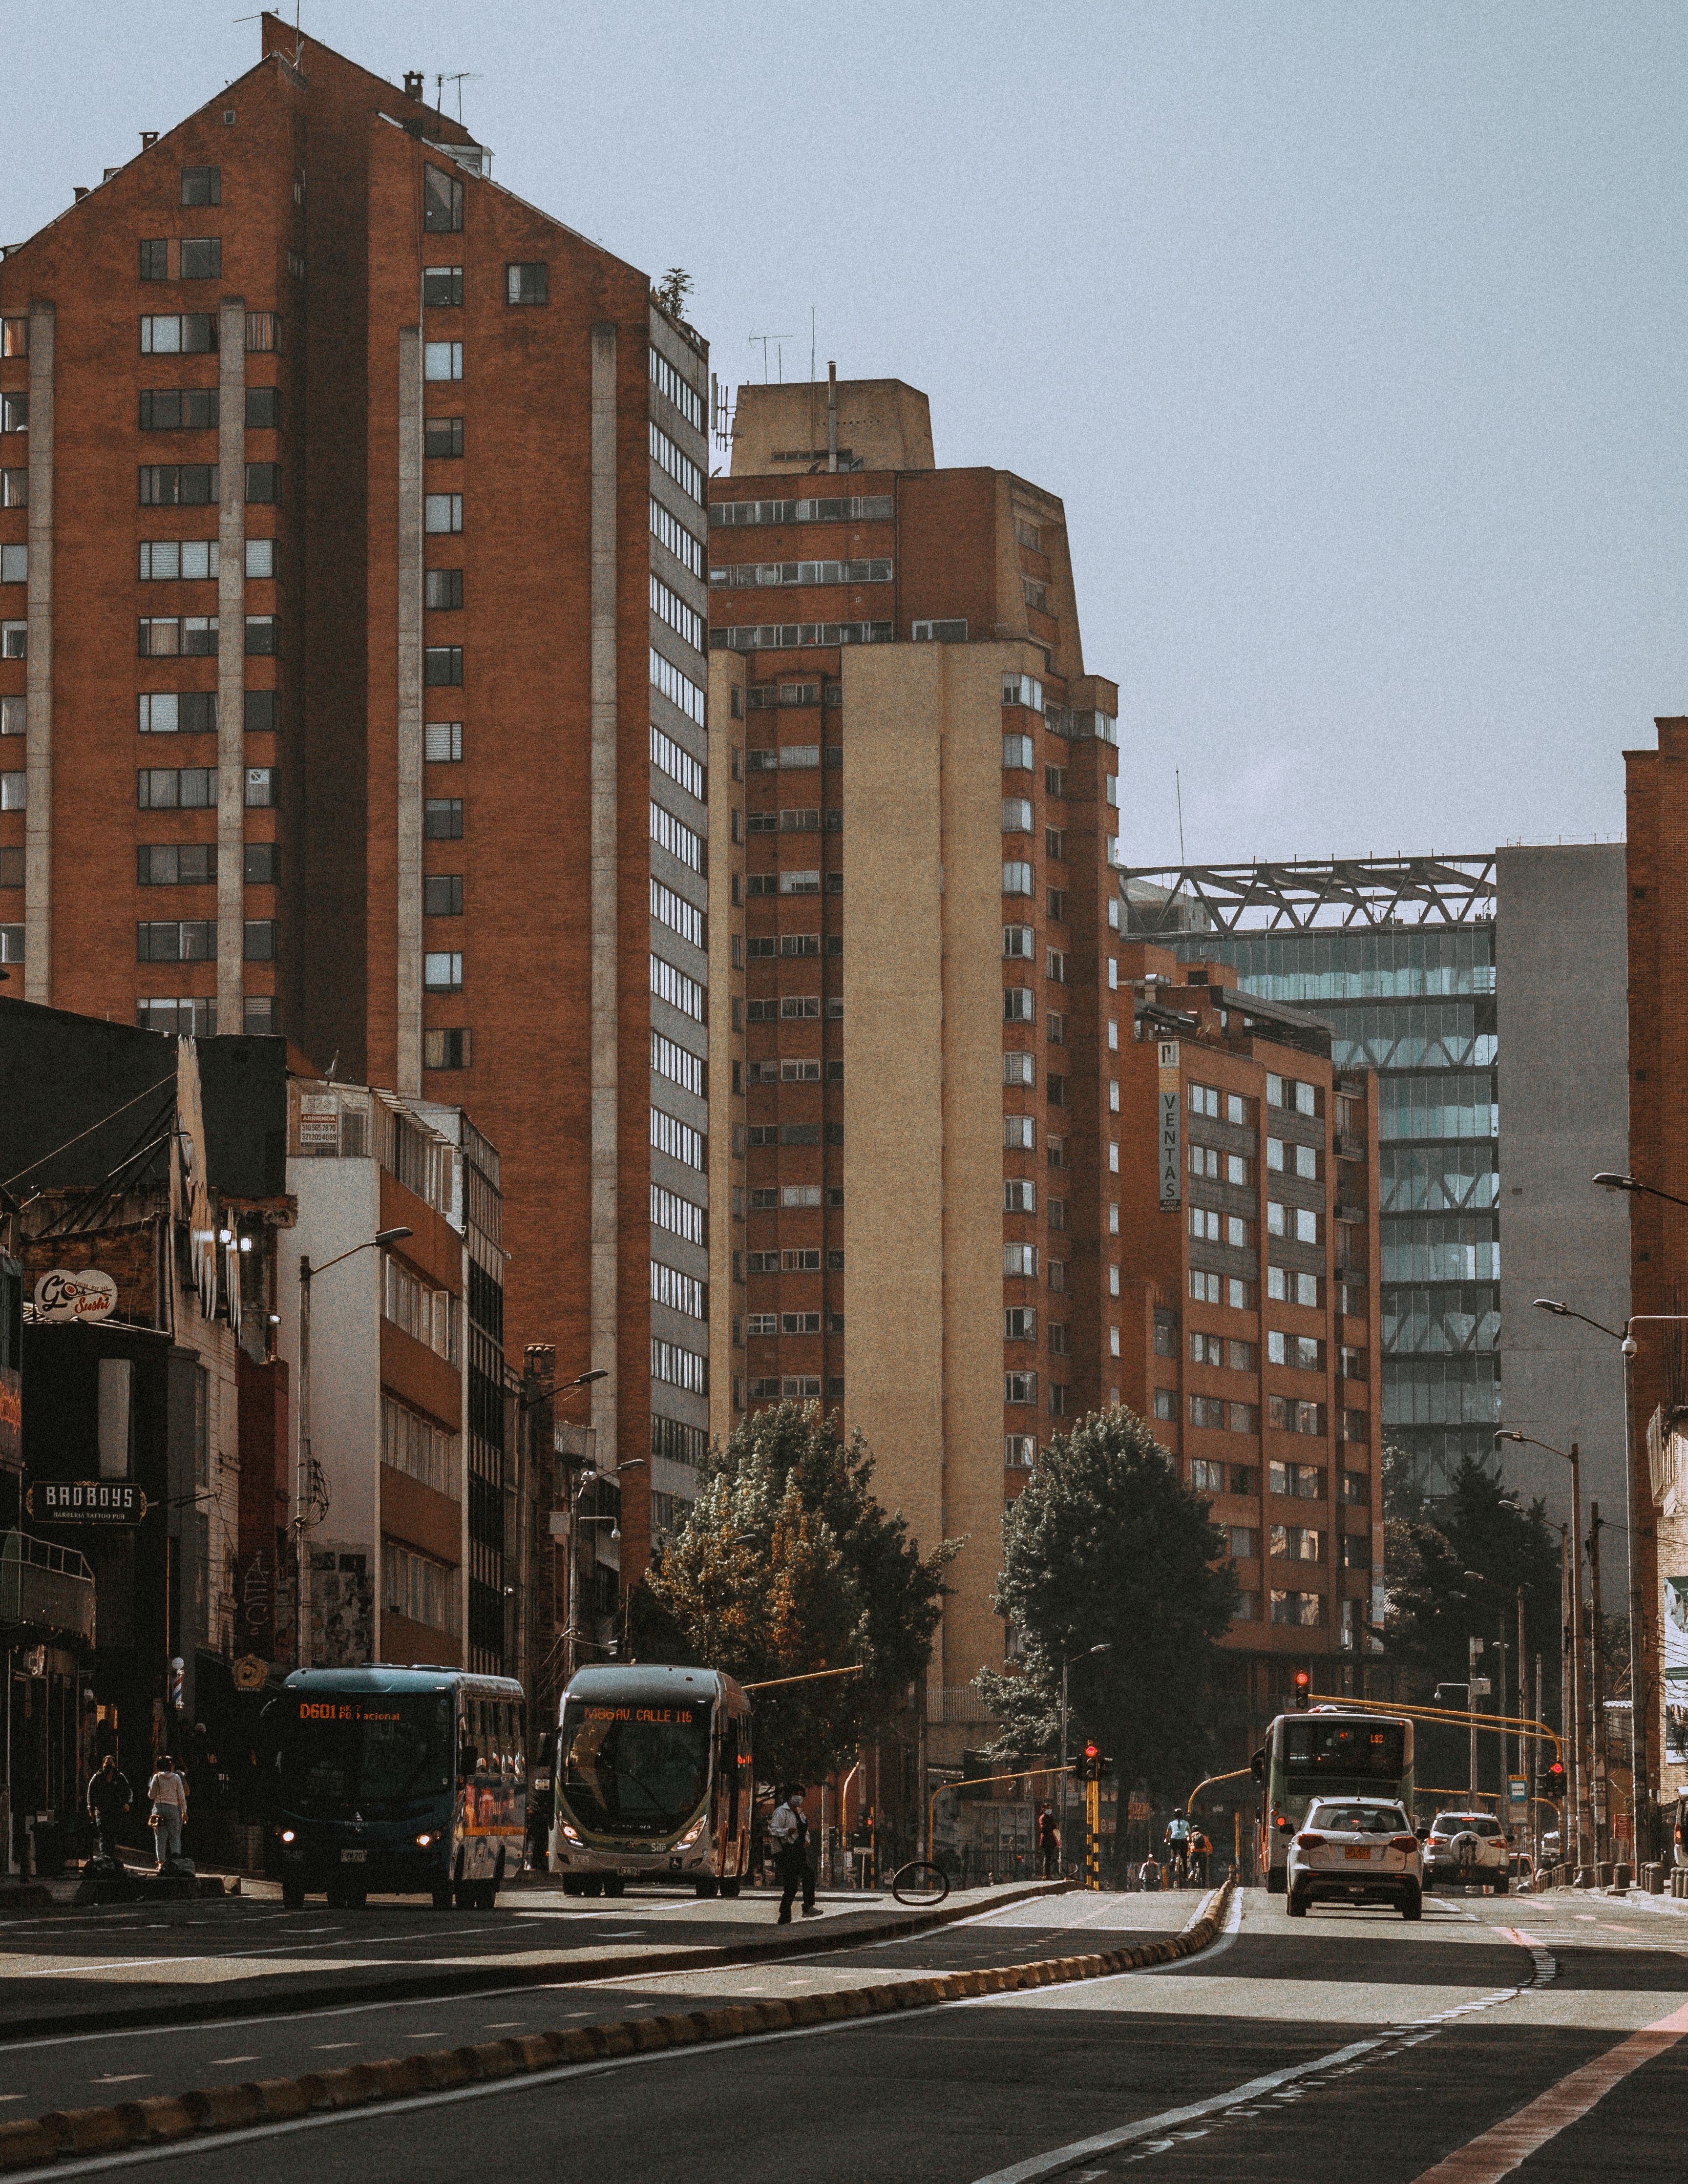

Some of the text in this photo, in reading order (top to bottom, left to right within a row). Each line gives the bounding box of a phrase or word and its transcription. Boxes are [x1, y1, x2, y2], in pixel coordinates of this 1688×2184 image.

[1163, 1095, 1177, 1197] VENTAS
[74, 1296, 110, 1314] Sushi
[299, 1703, 336, 1719] D601
[615, 1708, 633, 1721] AV.
[636, 1709, 672, 1722] CALLE
[676, 1710, 693, 1723] 116
